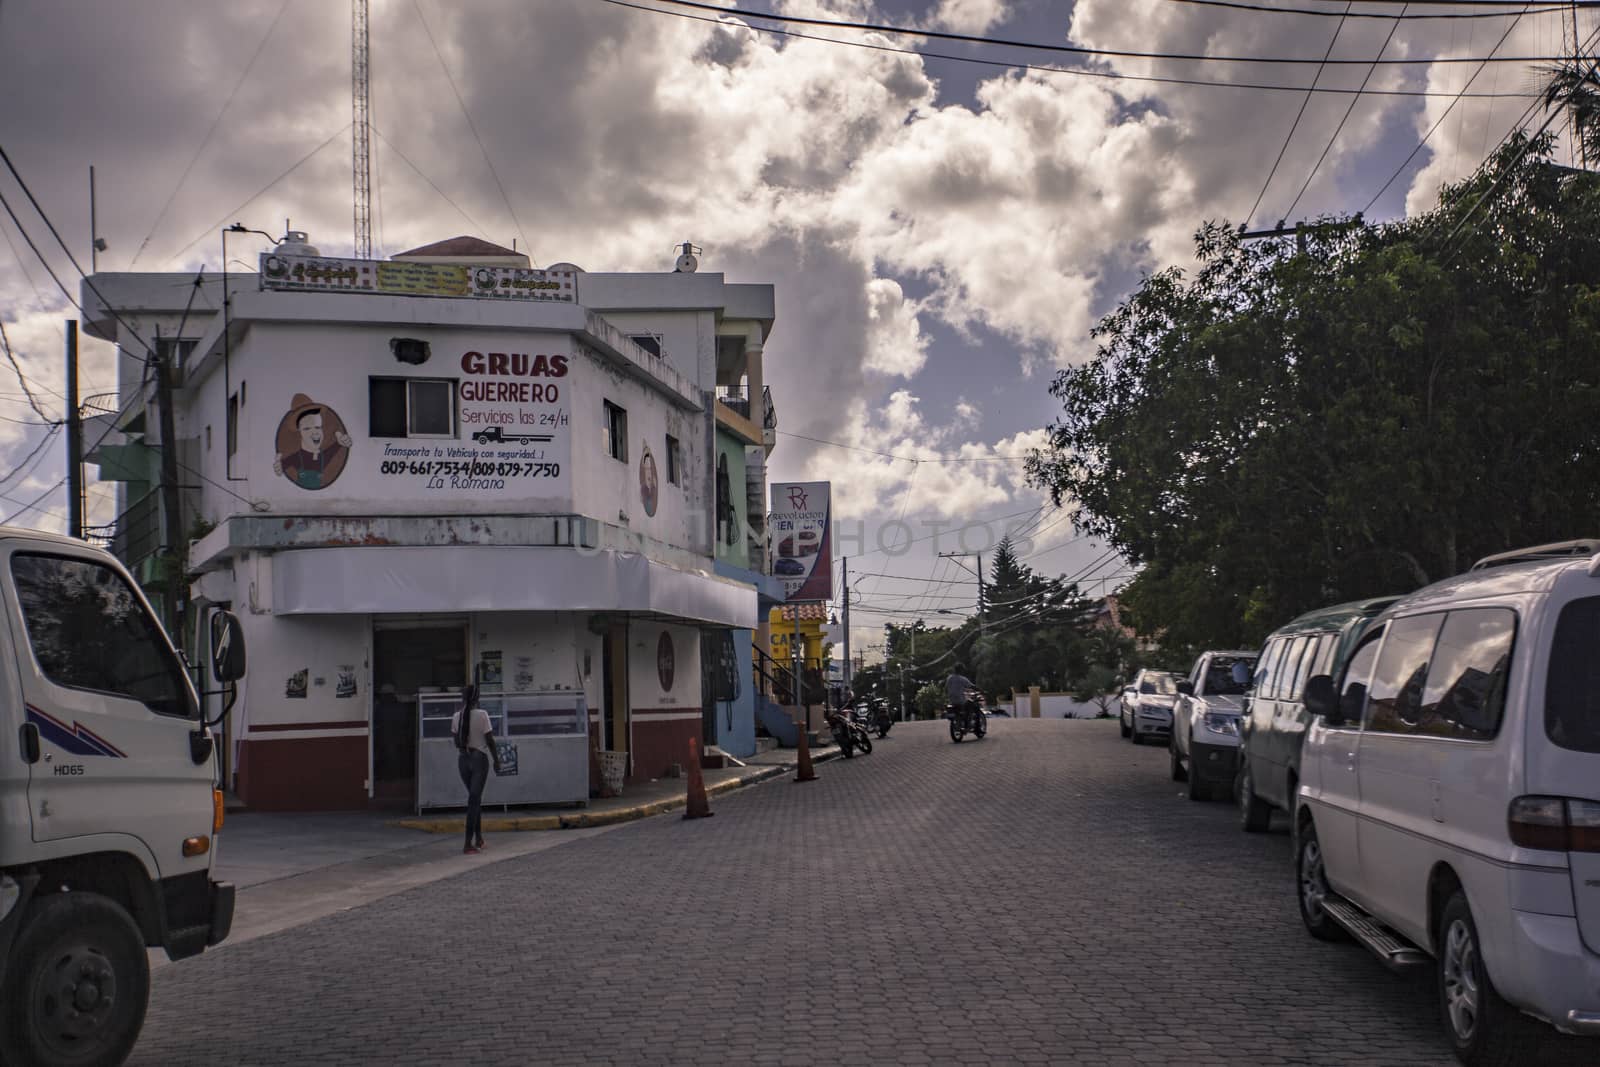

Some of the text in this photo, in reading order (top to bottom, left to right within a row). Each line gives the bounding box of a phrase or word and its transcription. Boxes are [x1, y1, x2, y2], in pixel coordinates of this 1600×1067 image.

[461, 351, 569, 378] GRUAS
[460, 381, 559, 404] GUERRERO
[462, 407, 569, 429] Servicios las 24/H
[384, 443, 430, 460] Transporta
[434, 446, 443, 457] tu
[480, 450, 494, 458] con
[426, 474, 505, 490] La Romana
